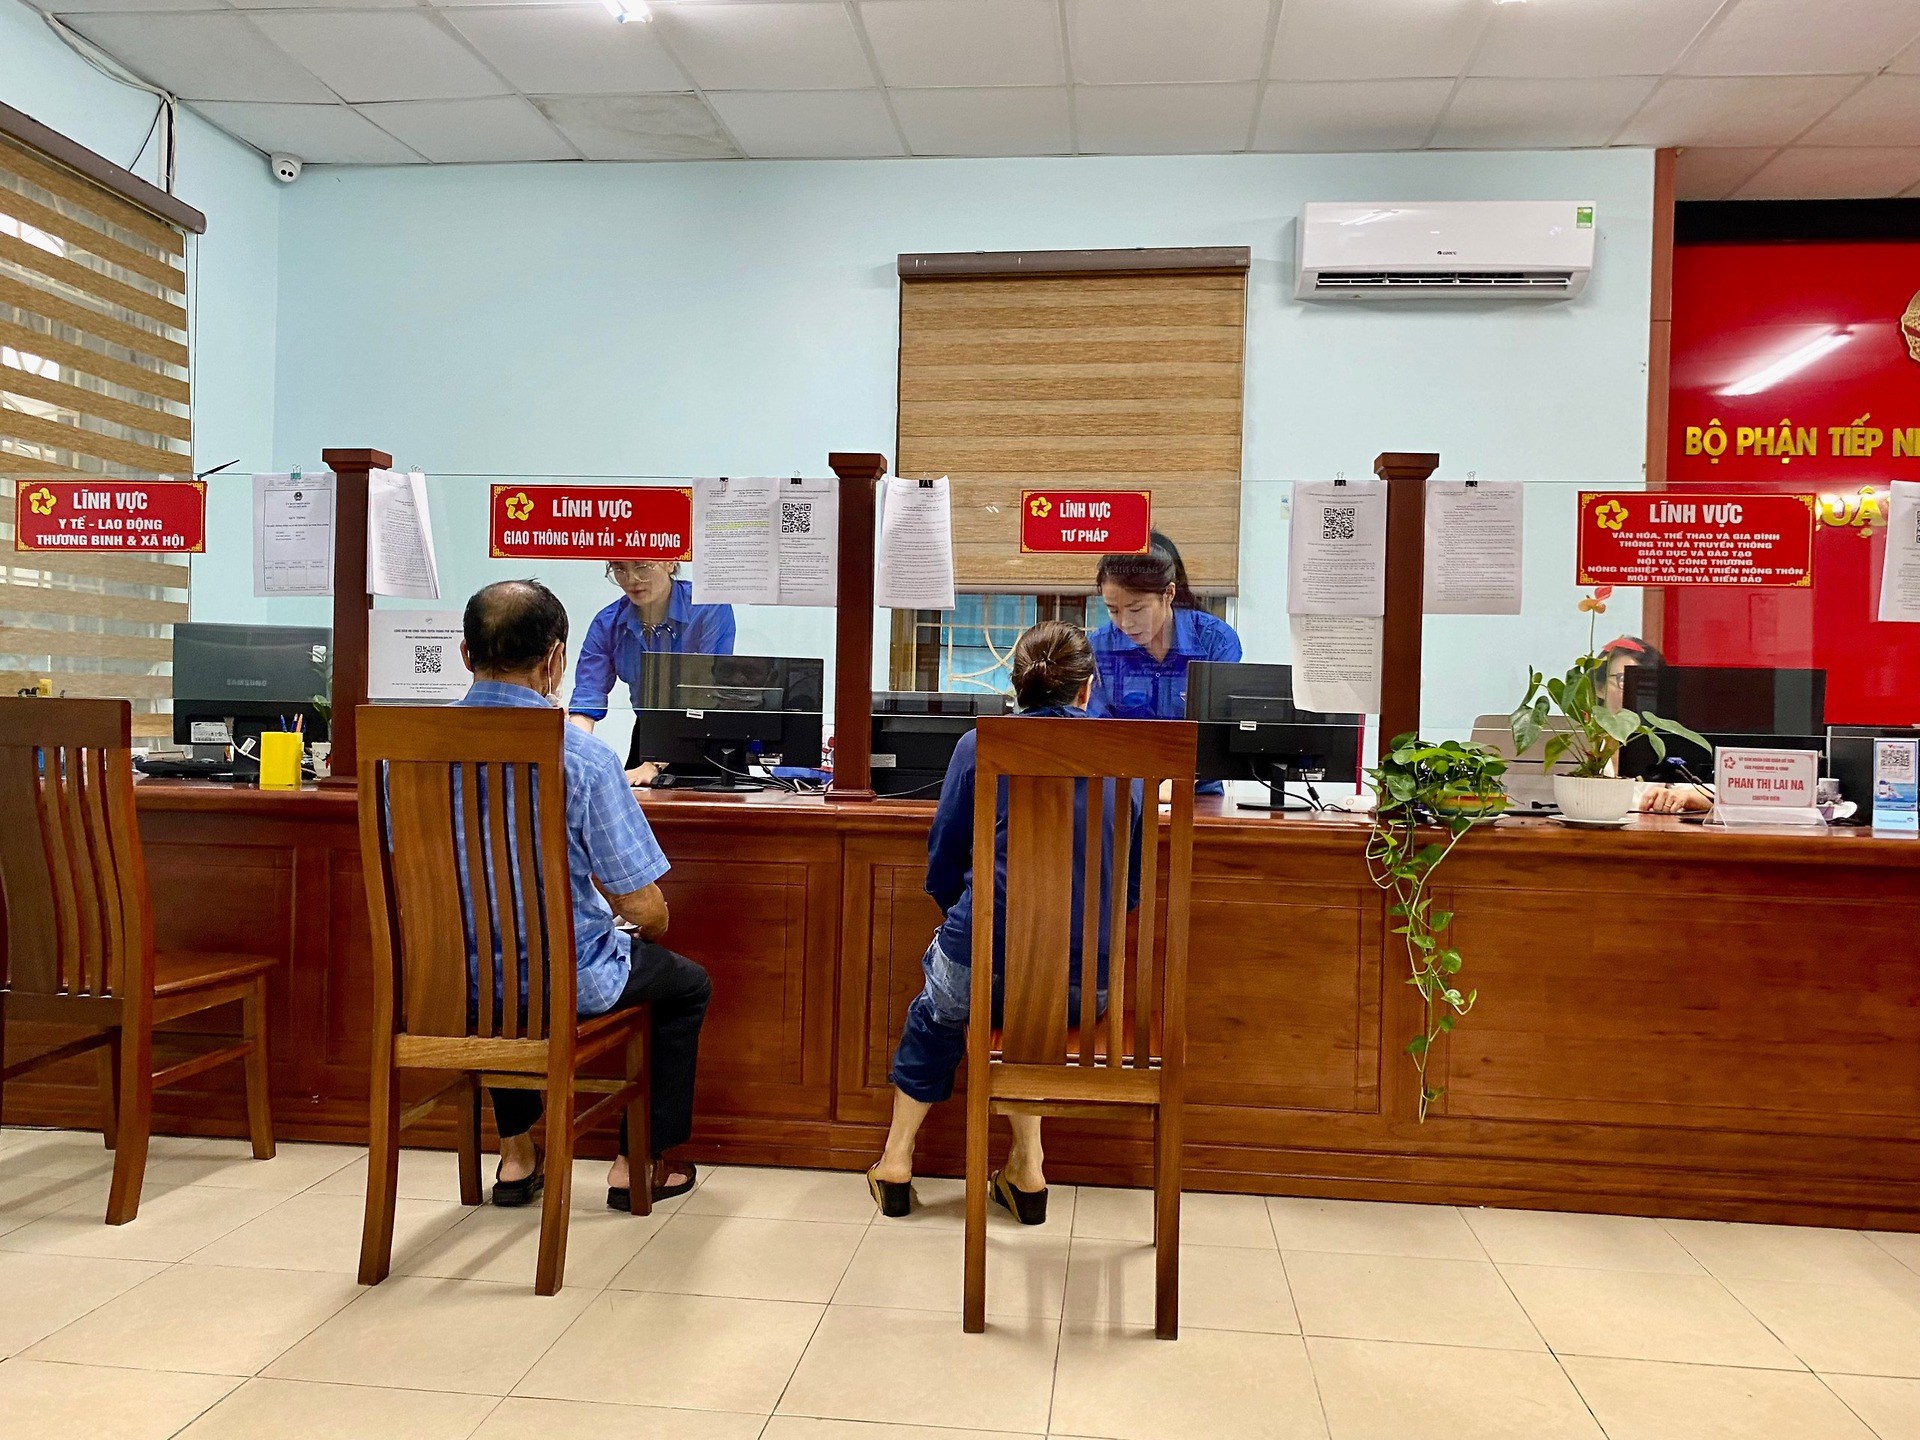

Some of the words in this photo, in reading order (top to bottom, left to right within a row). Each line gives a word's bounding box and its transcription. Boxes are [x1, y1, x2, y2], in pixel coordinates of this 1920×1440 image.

[1685, 417, 1727, 464] BỘ
[1736, 417, 1817, 464] PHẬN
[1828, 412, 1883, 457] TIẾP
[73, 489, 110, 510] LĨNH
[115, 491, 148, 513] VỰC
[552, 496, 592, 518] LĨNH
[598, 499, 633, 522] VỰC
[1059, 500, 1086, 518] LĨNH
[1088, 500, 1111, 522] VỰC
[1649, 500, 1696, 523] LĨNH
[1702, 502, 1743, 528] VỰC
[58, 519, 67, 530] Y
[70, 515, 86, 530] TẾ
[98, 519, 122, 530] LAO
[126, 517, 162, 532] ĐỘNG
[36, 534, 87, 546] THƯƠNG
[91, 535, 123, 546] BINH
[127, 536, 137, 546] &
[141, 534, 159, 546] XÃ
[162, 534, 185, 549] HỘI
[503, 530, 530, 545] GIAO
[532, 529, 569, 546] THÔNG
[572, 530, 594, 549] VẬN
[597, 526, 615, 547] TẢI
[625, 530, 647, 547] XÂY
[650, 532, 681, 551] DỰNG
[1060, 528, 1077, 542] TƯ
[1078, 527, 1109, 543] PHÁP
[1619, 540, 1654, 548] THÔNG
[1737, 541, 1772, 549] THÔNG
[1678, 558, 1708, 566] CÔNG
[1742, 567, 1772, 575] NÔNG
[1775, 567, 1804, 575] THÔN
[226, 679, 268, 687] SAMSUNG
[1728, 777, 1754, 789] PHAN
[1757, 778, 1771, 791] THỊ
[1774, 779, 1788, 790] LAI
[1791, 780, 1804, 791] NA
